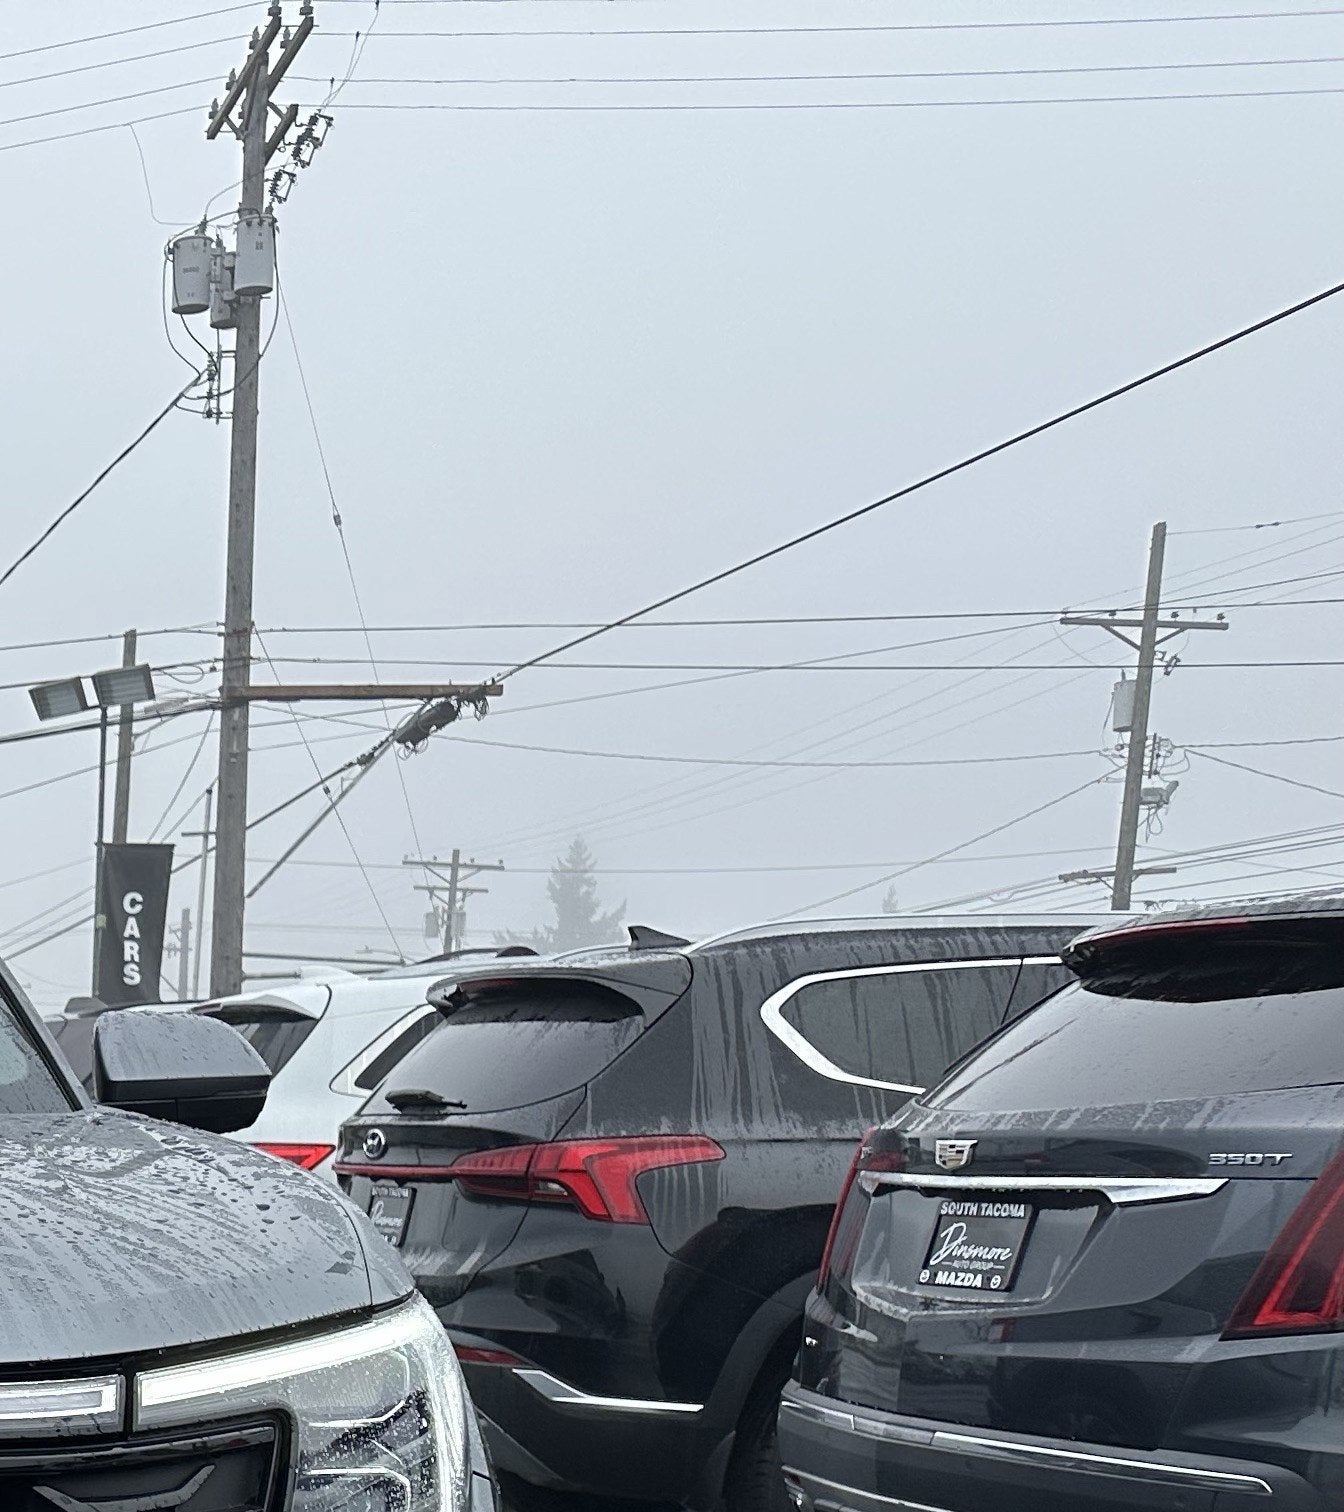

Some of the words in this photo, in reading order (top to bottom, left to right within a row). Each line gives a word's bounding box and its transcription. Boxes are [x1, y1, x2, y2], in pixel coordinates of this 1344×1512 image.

[122, 891, 144, 986] CARS
[1208, 1153, 1293, 1165] 350T
[940, 1201, 978, 1216] SOUTH
[980, 1203, 1025, 1218] TACOMA
[929, 1222, 1012, 1265] Dinsmore
[934, 1271, 983, 1288] MAZDA
